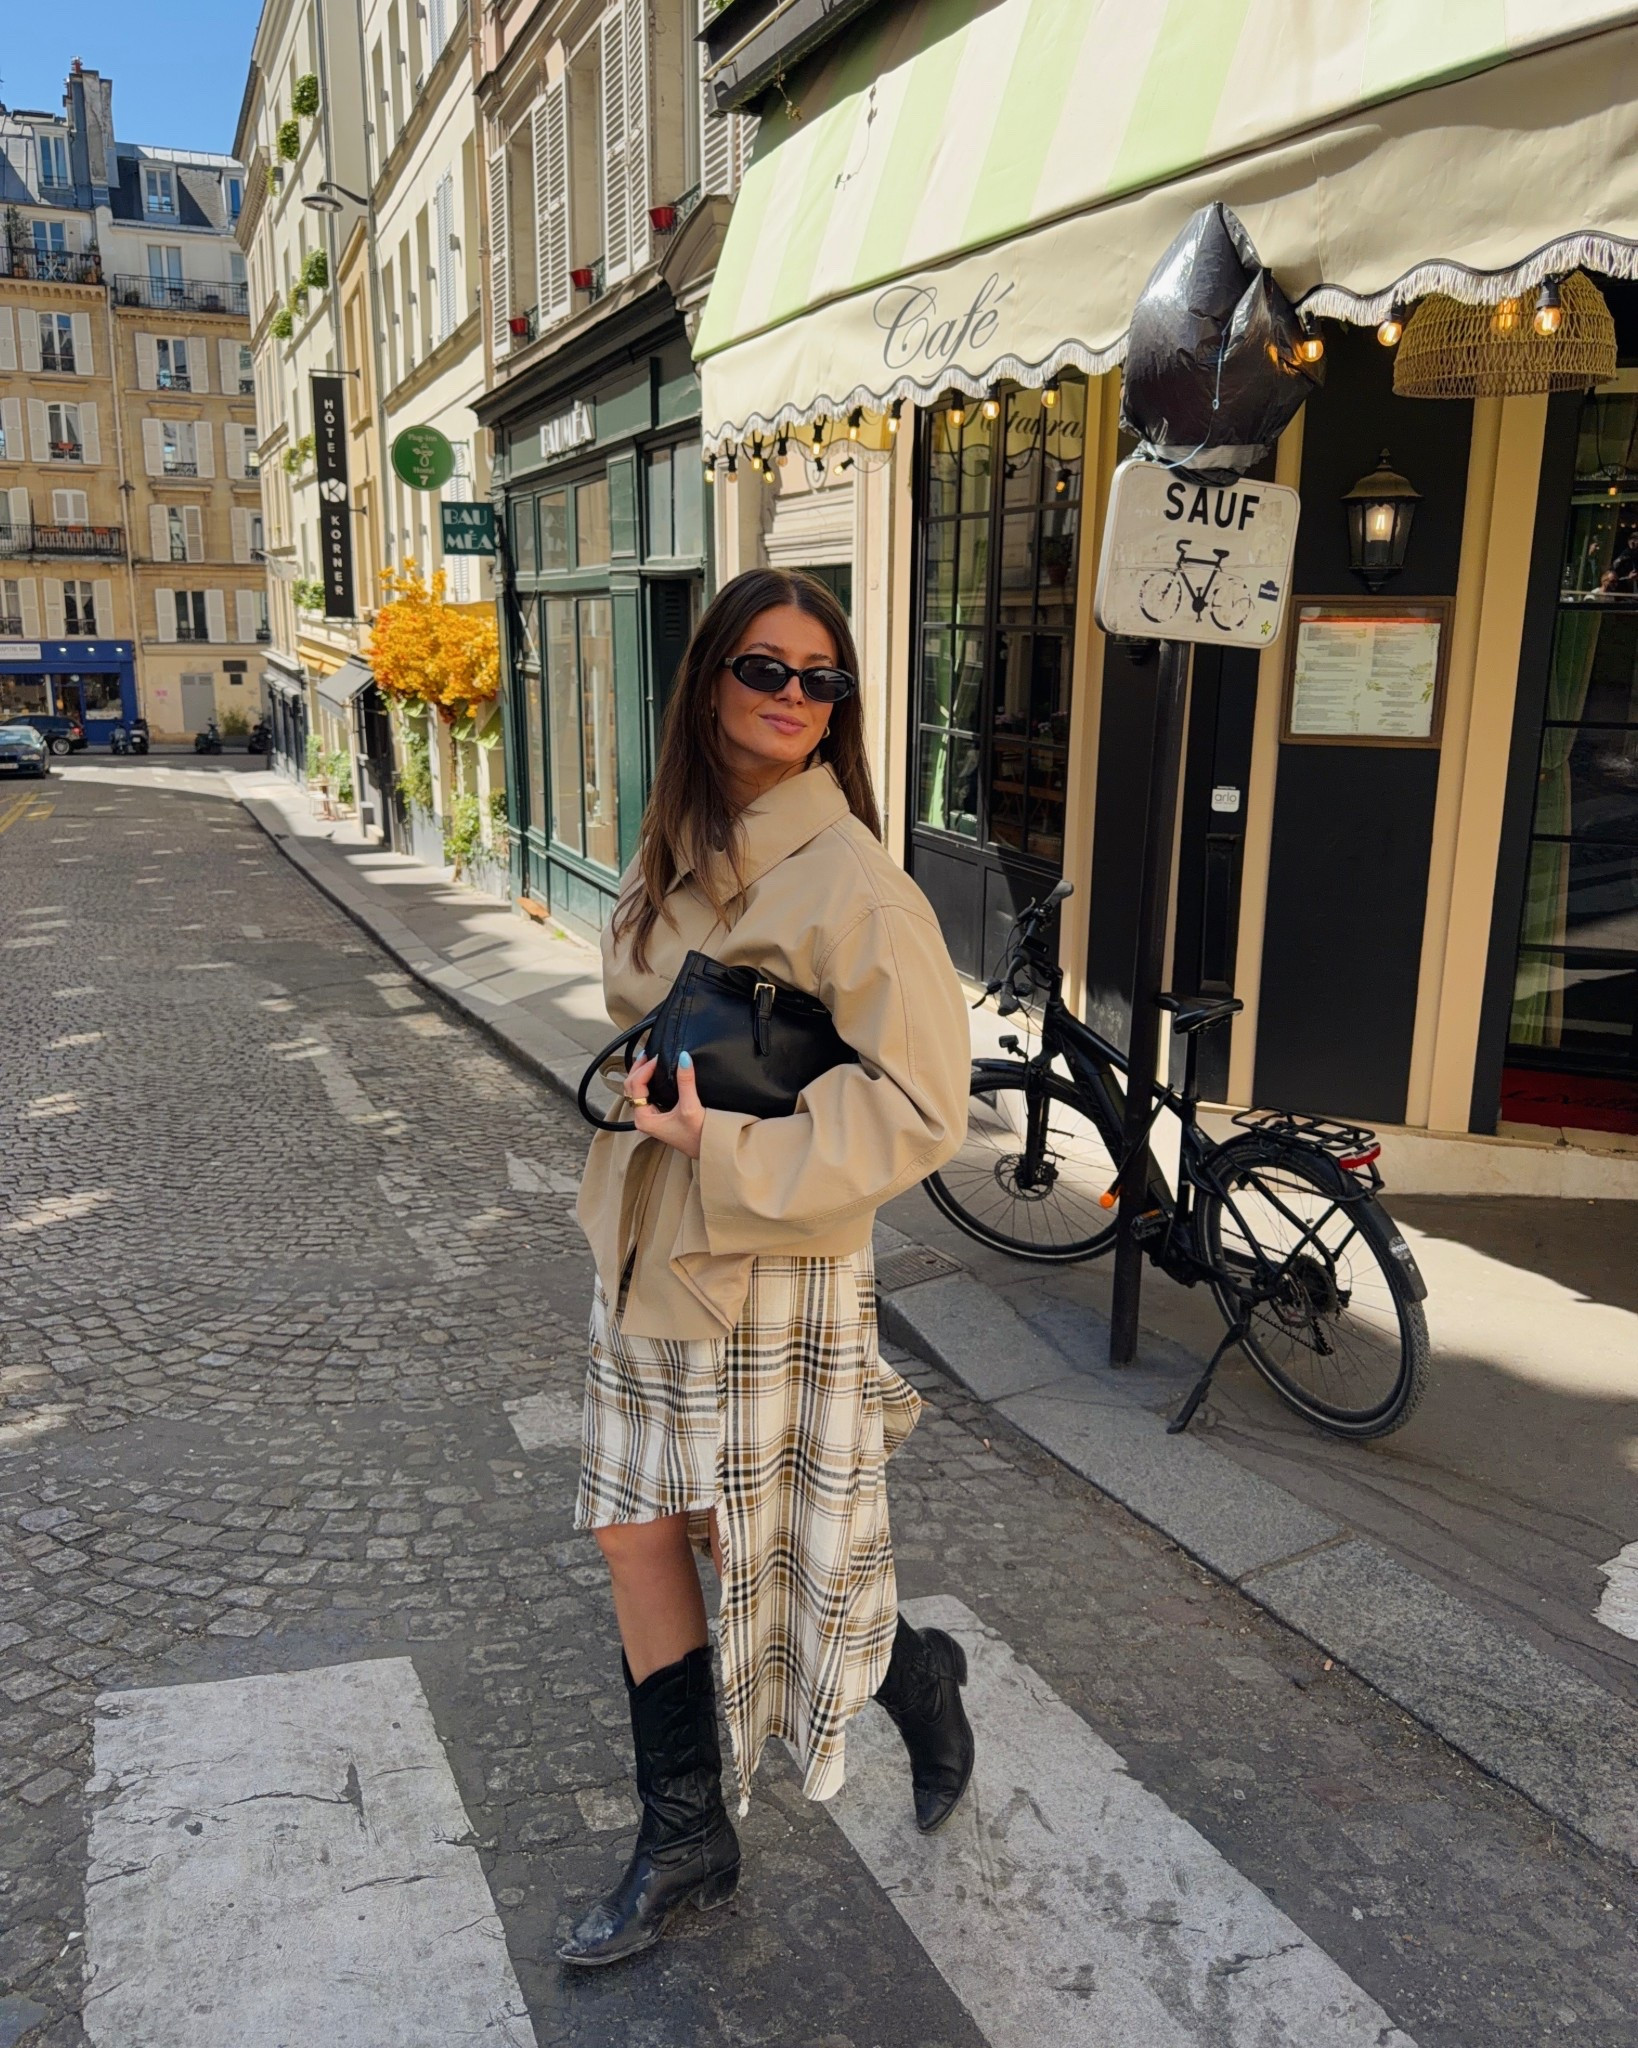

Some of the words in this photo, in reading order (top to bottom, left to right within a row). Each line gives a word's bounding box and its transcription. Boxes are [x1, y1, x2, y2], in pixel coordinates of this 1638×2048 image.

[872, 272, 1015, 379] Café
[420, 475, 429, 486] 7
[323, 398, 337, 468] HÔTEL
[330, 515, 344, 596] KORNER
[1163, 482, 1261, 531] SAUF
[443, 508, 488, 526] BAU
[445, 529, 494, 550] MÉA
[1214, 791, 1237, 803] arlo
